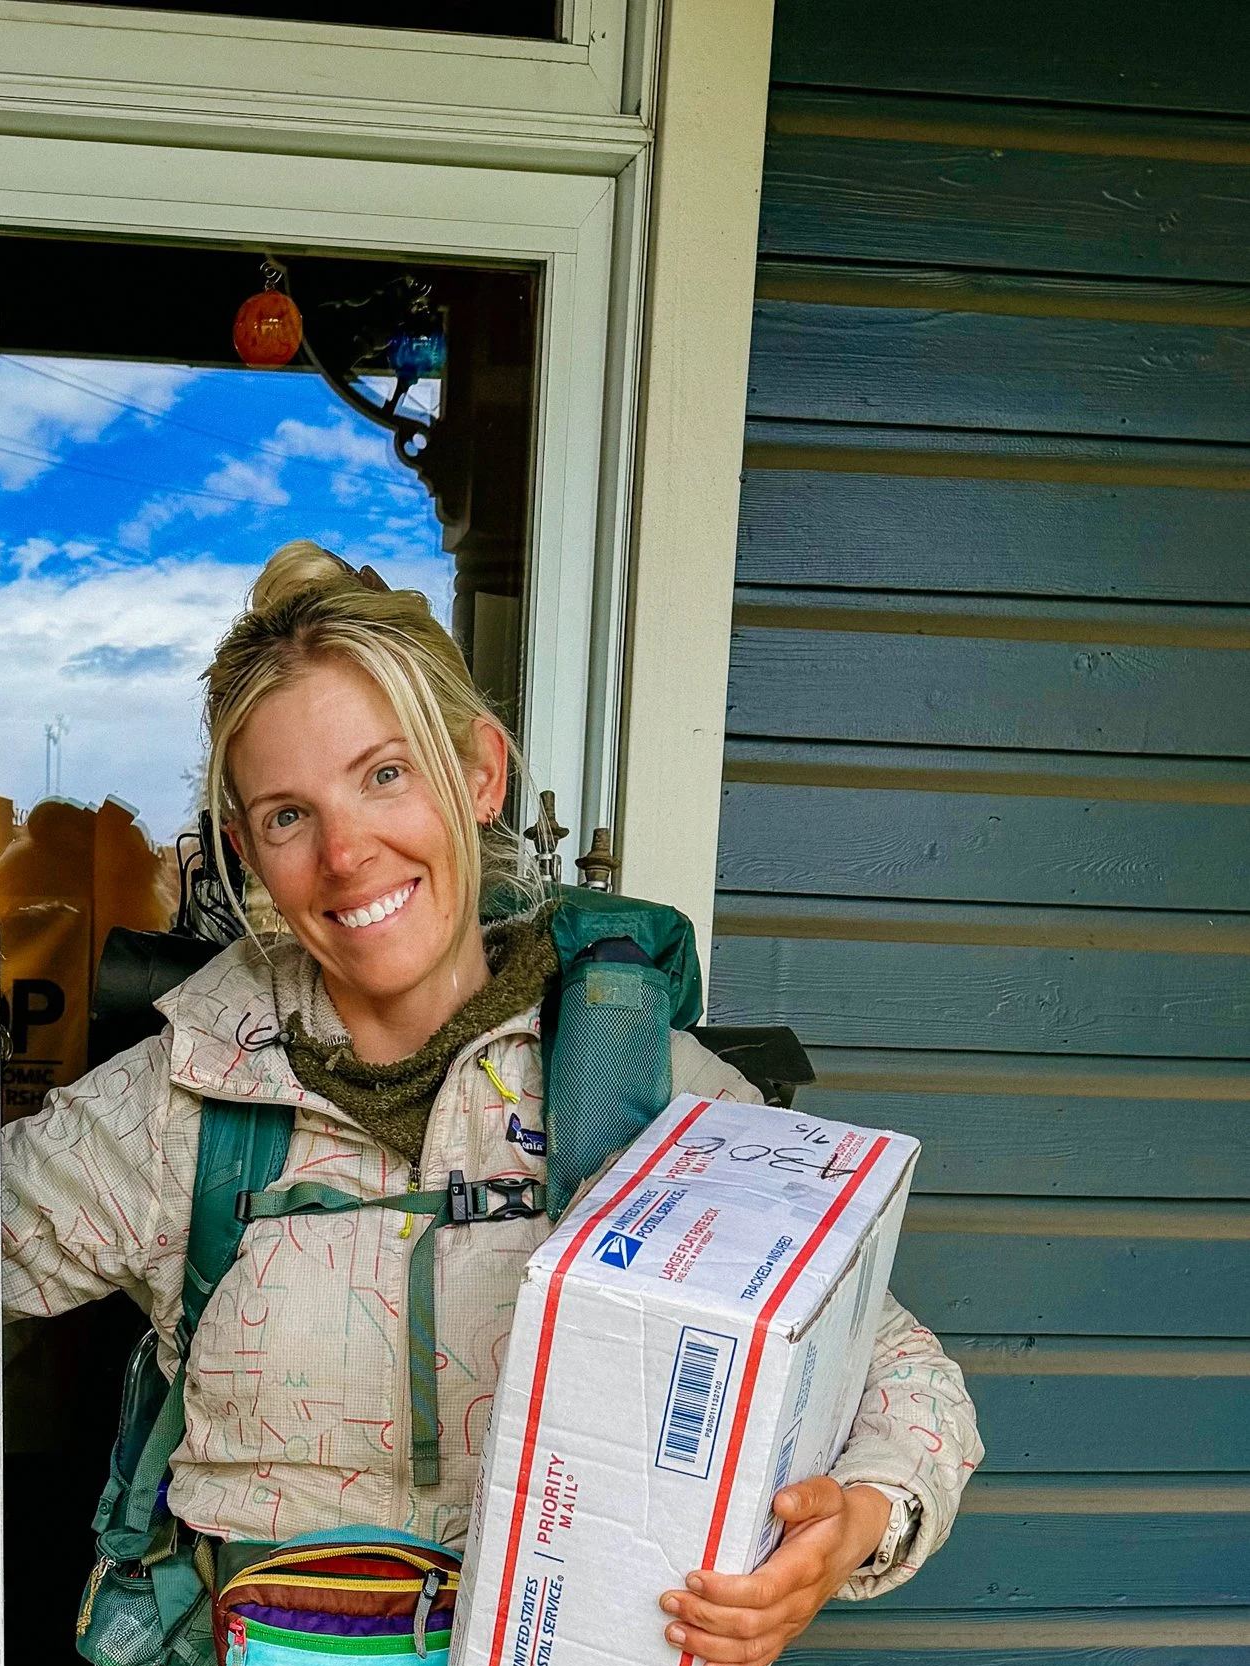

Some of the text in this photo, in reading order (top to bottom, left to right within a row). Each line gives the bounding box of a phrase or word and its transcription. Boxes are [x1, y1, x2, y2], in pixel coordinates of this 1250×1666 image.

[0, 978, 66, 1054] P
[2, 1067, 56, 1086] OMIC
[612, 1190, 659, 1231] UNITED STATES
[636, 1214, 665, 1239] POSTAL
[658, 1207, 721, 1281] LARGE FLAT RATE BOX
[740, 1235, 793, 1300] TRACKED INSURED
[537, 1452, 565, 1545] PRIORITY
[520, 1575, 538, 1626] STATES
